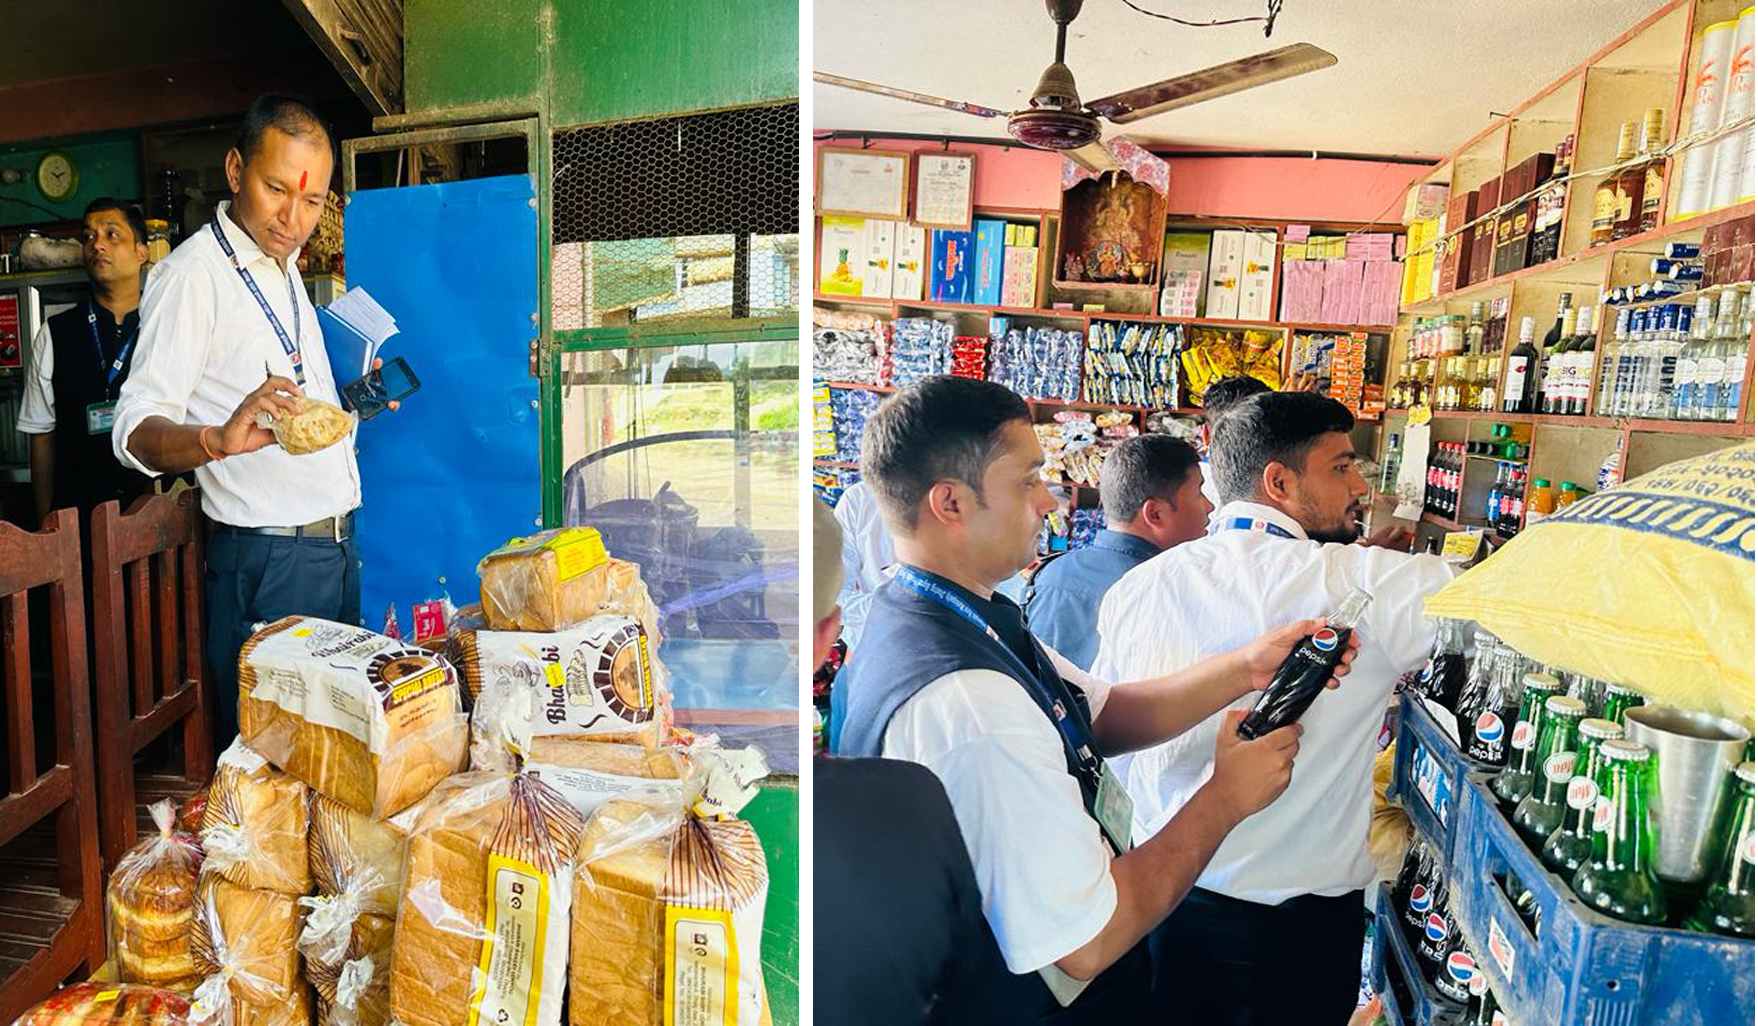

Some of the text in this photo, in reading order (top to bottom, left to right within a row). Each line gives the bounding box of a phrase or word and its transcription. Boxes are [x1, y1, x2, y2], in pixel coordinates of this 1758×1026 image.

[312, 632, 376, 659] Bhairabi
[393, 669, 445, 704] SPECIAL BREAD
[541, 644, 566, 725] Bhaibi
